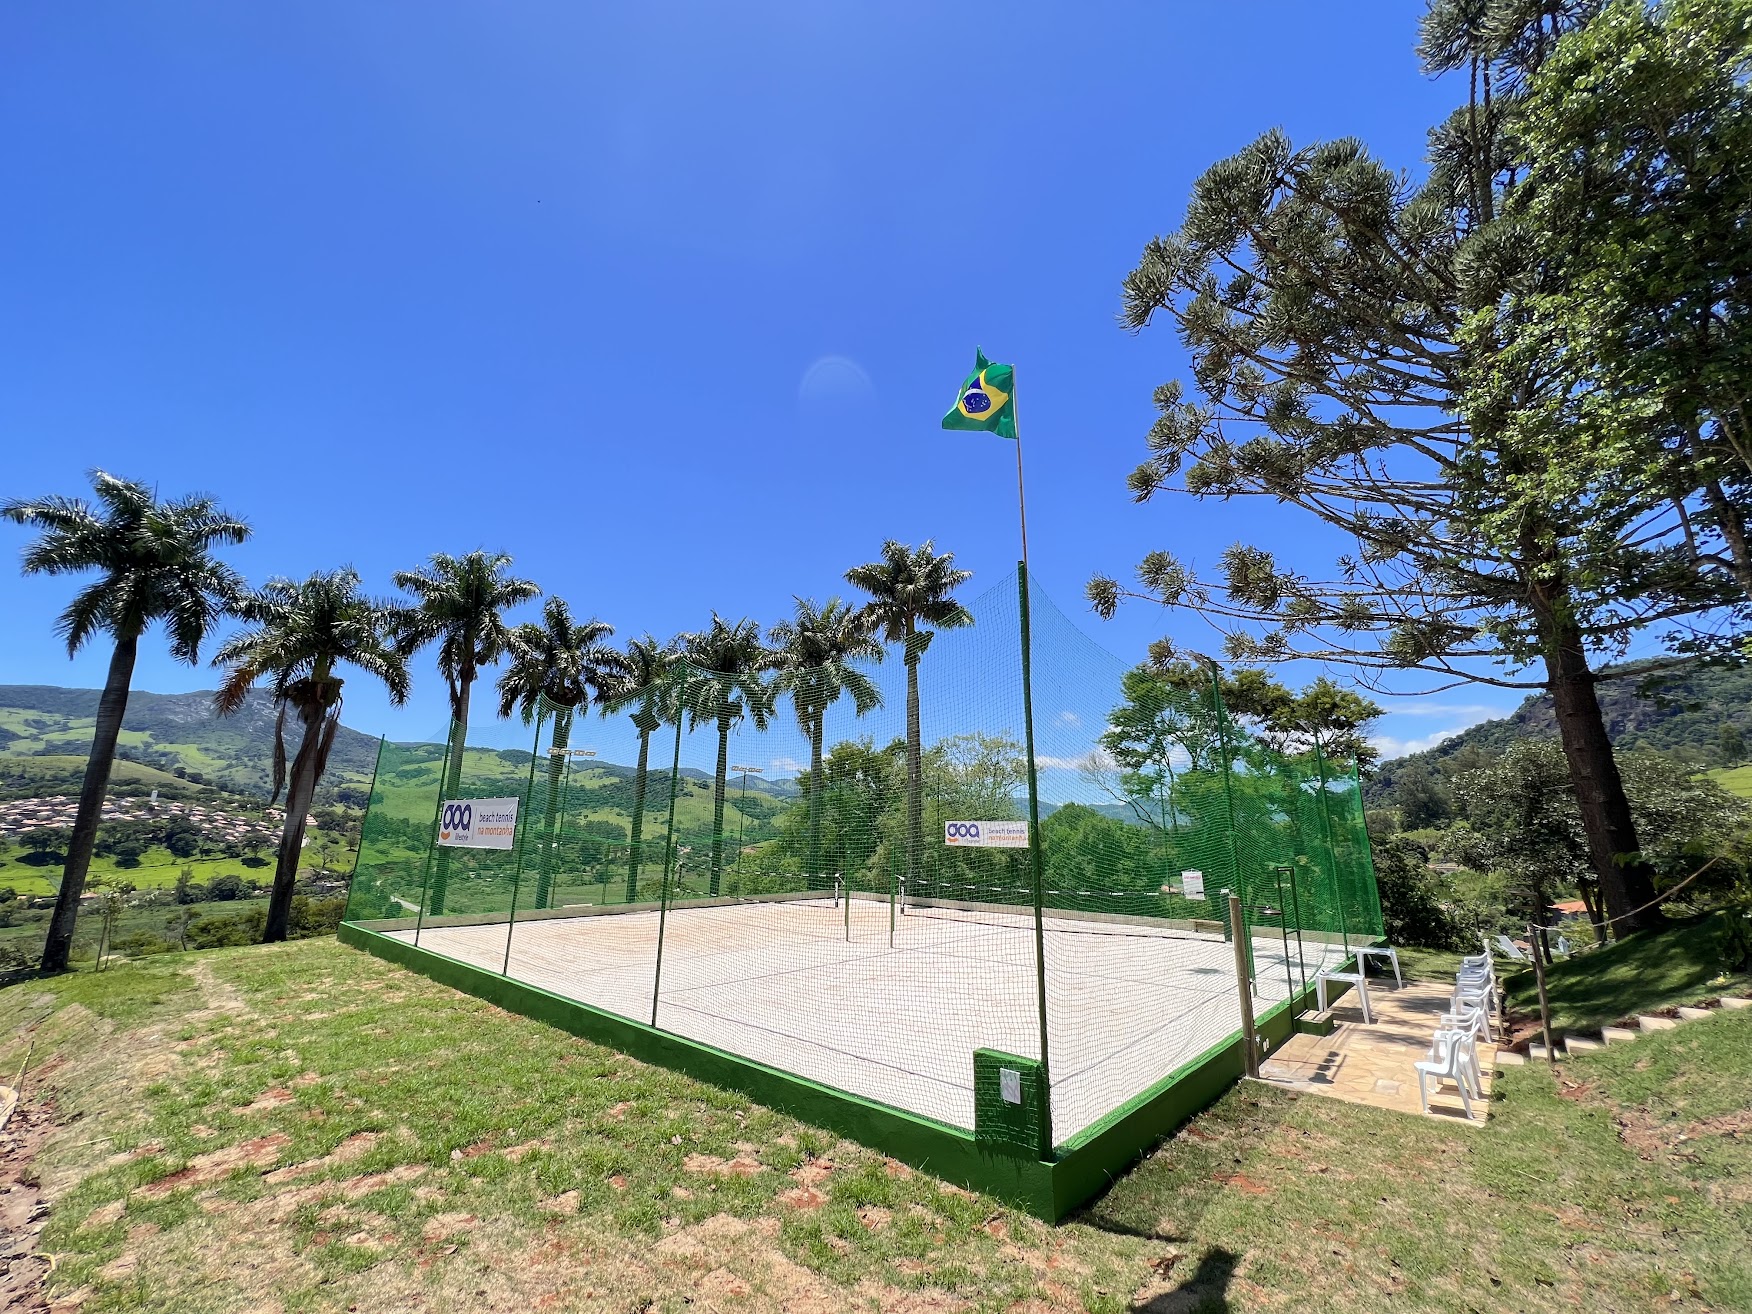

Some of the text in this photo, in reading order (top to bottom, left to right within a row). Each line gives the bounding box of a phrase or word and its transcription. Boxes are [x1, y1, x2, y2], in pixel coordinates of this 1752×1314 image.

[479, 811, 513, 822] beach tennis
[477, 827, 484, 835] na
